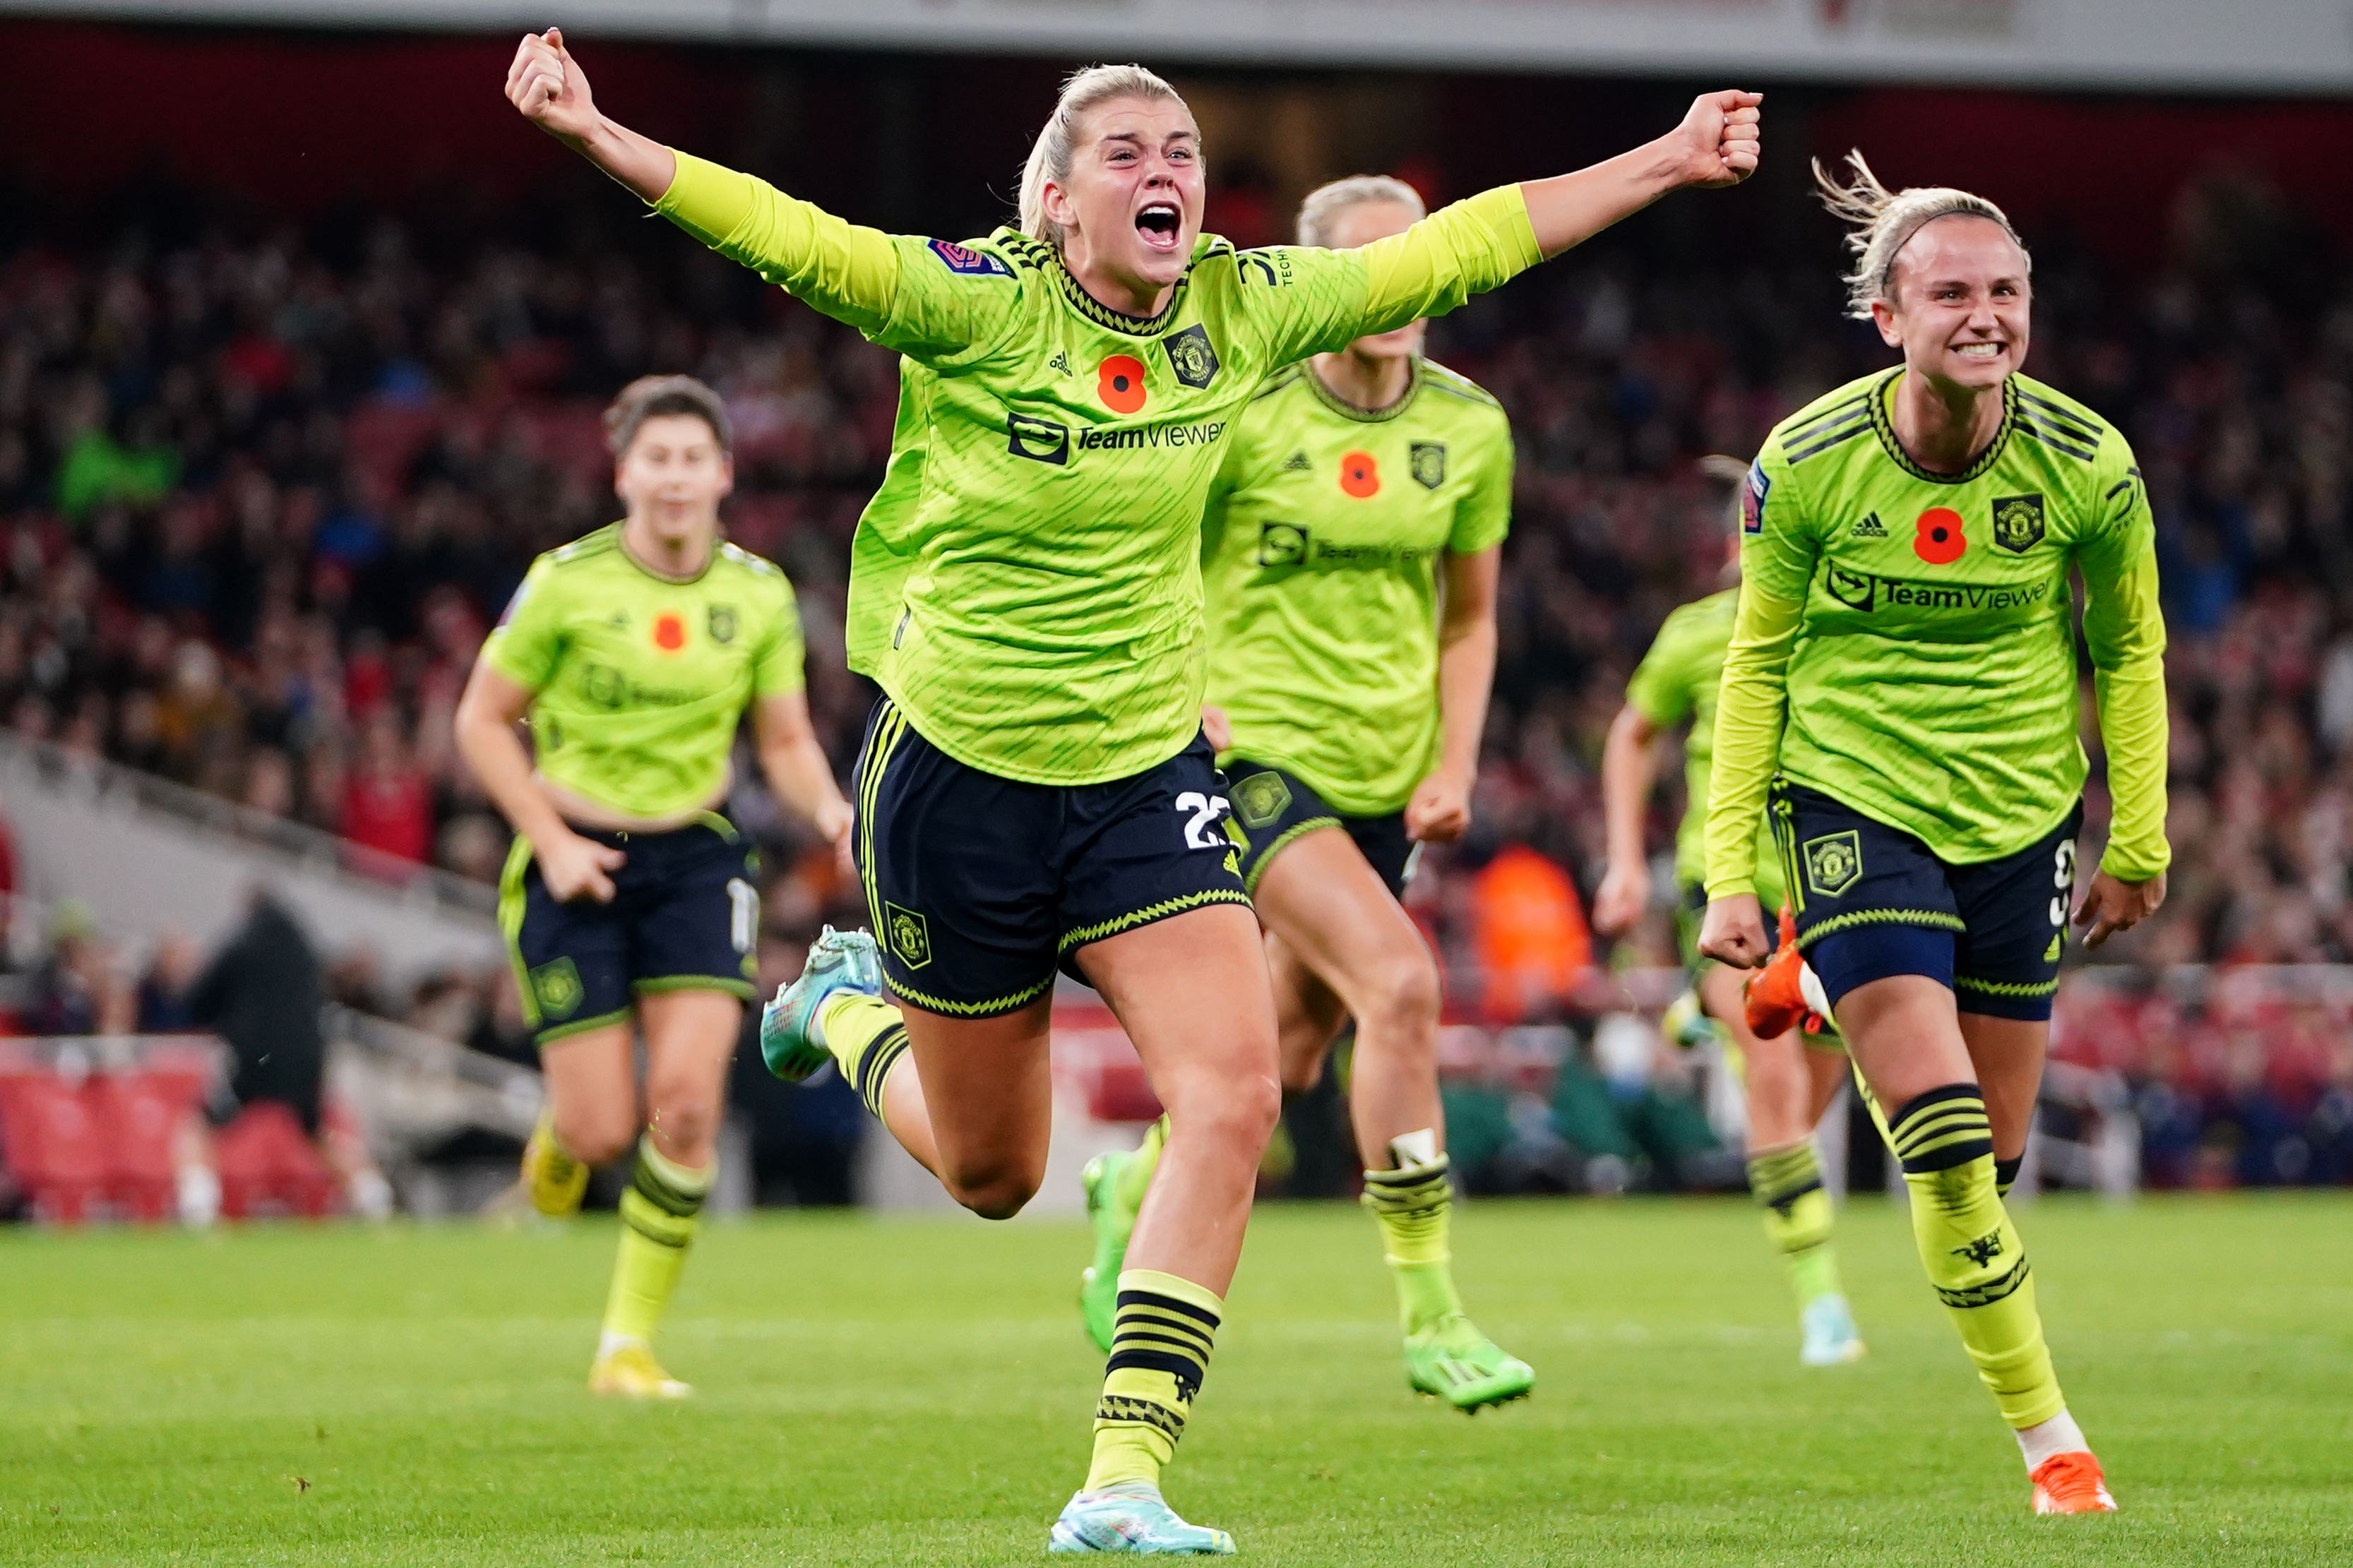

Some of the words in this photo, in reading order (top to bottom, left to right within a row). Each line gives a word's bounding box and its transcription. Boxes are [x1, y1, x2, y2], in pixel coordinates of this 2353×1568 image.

[1078, 421, 1227, 450] TeamViewer
[1851, 527, 1888, 537] adidas
[1881, 576, 2051, 610] TeamViewer
